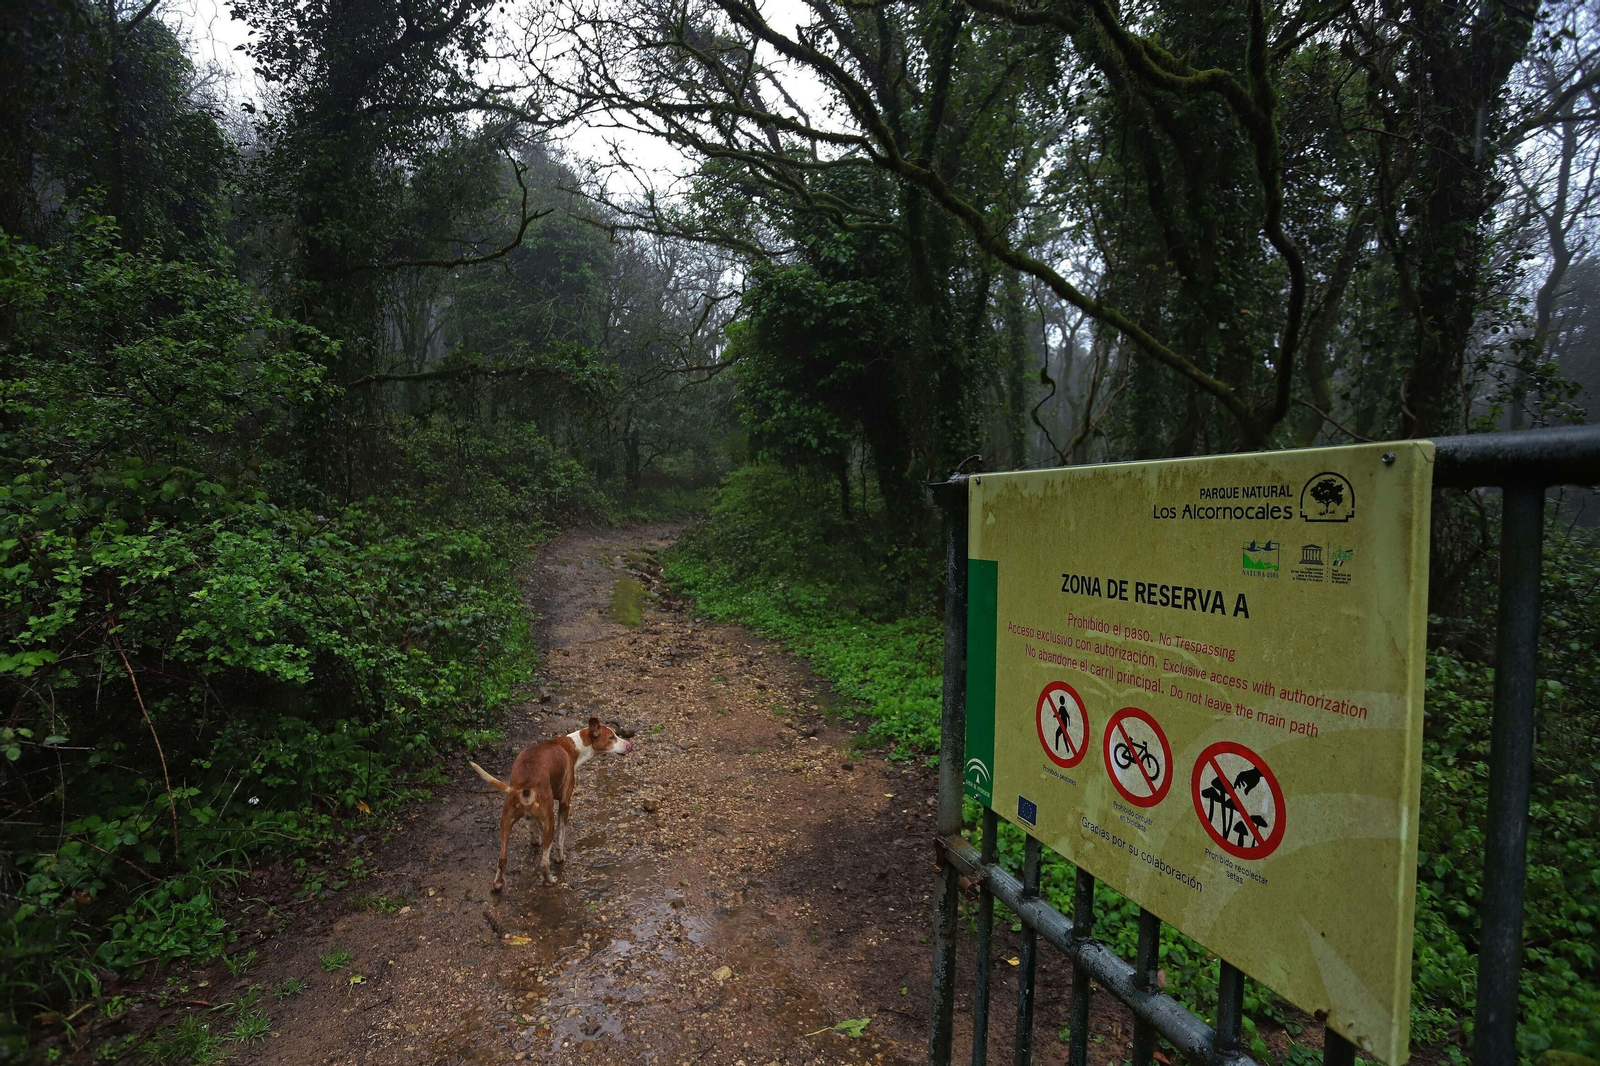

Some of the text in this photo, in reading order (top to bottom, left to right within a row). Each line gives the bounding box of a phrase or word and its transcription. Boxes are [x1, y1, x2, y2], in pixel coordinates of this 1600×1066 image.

[1200, 485, 1293, 500] PARQUE NATURAL
[1153, 502, 1293, 520] Los Alcornocales
[1242, 570, 1265, 578] NATURA
[1061, 573, 1250, 619] ZONA DE RESERVA A
[1067, 612, 1236, 663] Prohibido el paso. No Trespassing
[1007, 620, 1368, 720] Acceso exclusivo con autorización. Exclusive access with authorization
[1025, 643, 1319, 738] No abandone el carril principal. Do not leave the main path
[1042, 764, 1059, 778] Prohibido
[1112, 801, 1153, 826] Prohibido circular
[1126, 816, 1147, 832] bicicleta
[1081, 816, 1203, 893] Gracias por su colaboración
[1204, 848, 1269, 886] Prohibido recolectar
[1225, 869, 1244, 885] setas
